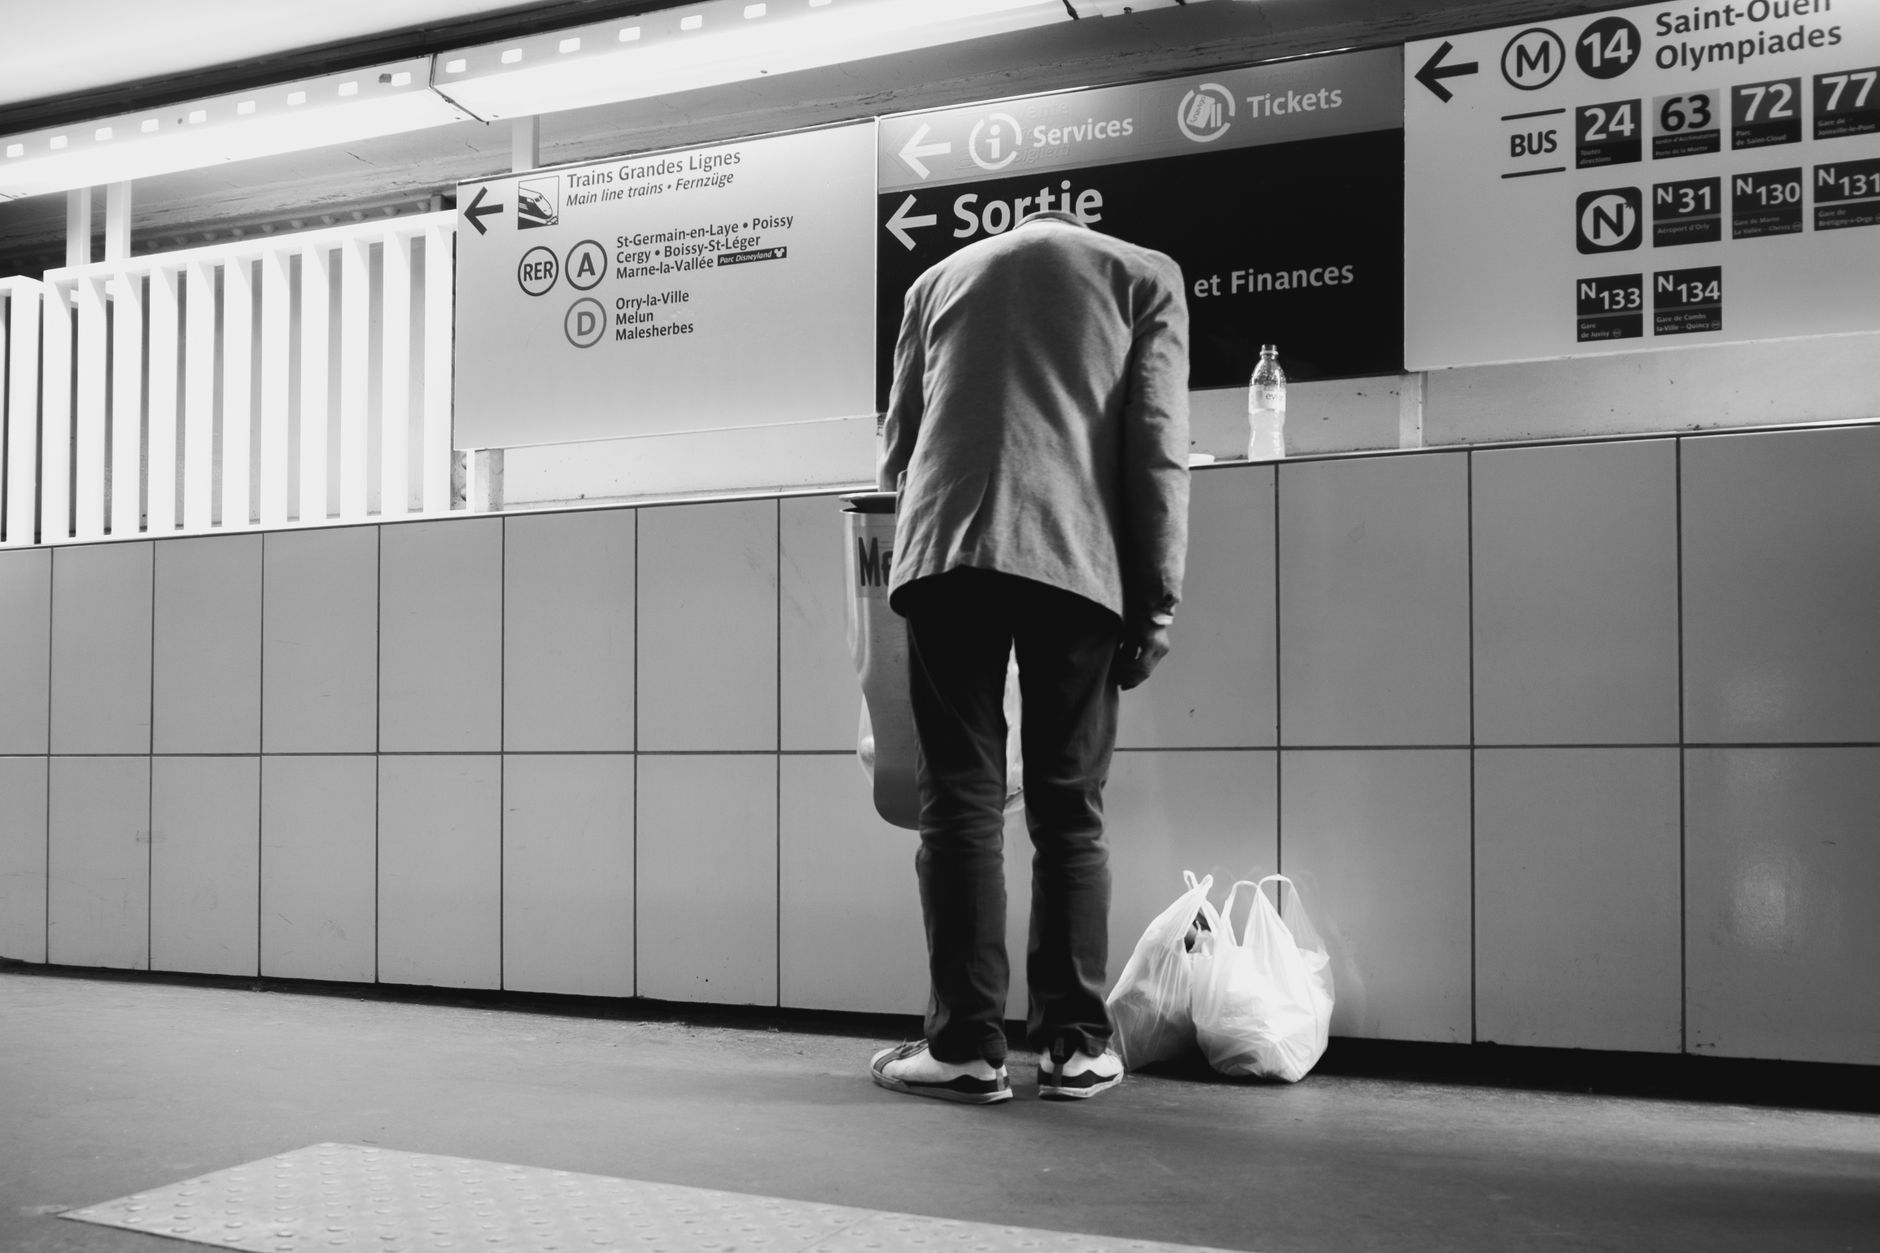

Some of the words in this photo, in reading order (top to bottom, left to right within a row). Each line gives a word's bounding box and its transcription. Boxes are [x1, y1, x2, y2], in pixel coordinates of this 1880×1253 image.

[1516, 40, 1550, 78] M
[1582, 27, 1633, 68] 14
[1655, 24, 1842, 72] Olympiades
[1246, 87, 1343, 119] Tickets
[1740, 82, 1793, 122] 72
[1821, 71, 1878, 111] 77
[1583, 103, 1635, 142] 24
[1660, 93, 1712, 132] 63
[1032, 117, 1134, 148] Services
[1510, 129, 1558, 158] BUS
[566, 170, 613, 189] Trains
[618, 159, 683, 182] Grandes
[689, 151, 741, 173] Lignes
[566, 191, 597, 207] Main
[601, 187, 624, 202] line
[627, 182, 664, 198] trains
[675, 171, 734, 192] Fernzüge
[952, 179, 1103, 238] Sortie
[616, 223, 739, 249] St-Germain-en-Laye
[752, 215, 794, 231] Poissy
[576, 252, 596, 278] A
[616, 250, 651, 264] Cergy
[664, 236, 761, 258] Boissy-St-Léger
[616, 256, 714, 279] Marne-la-Vallée
[719, 256, 734, 264] Parc
[735, 250, 773, 262] Disneyland
[523, 260, 554, 282] RER
[1194, 273, 1222, 298] et
[1231, 264, 1354, 295] Finances
[615, 290, 690, 311] Orry-la-Ville
[577, 310, 596, 337] D
[615, 311, 654, 326] Melun
[615, 322, 694, 341] Malesherbes
